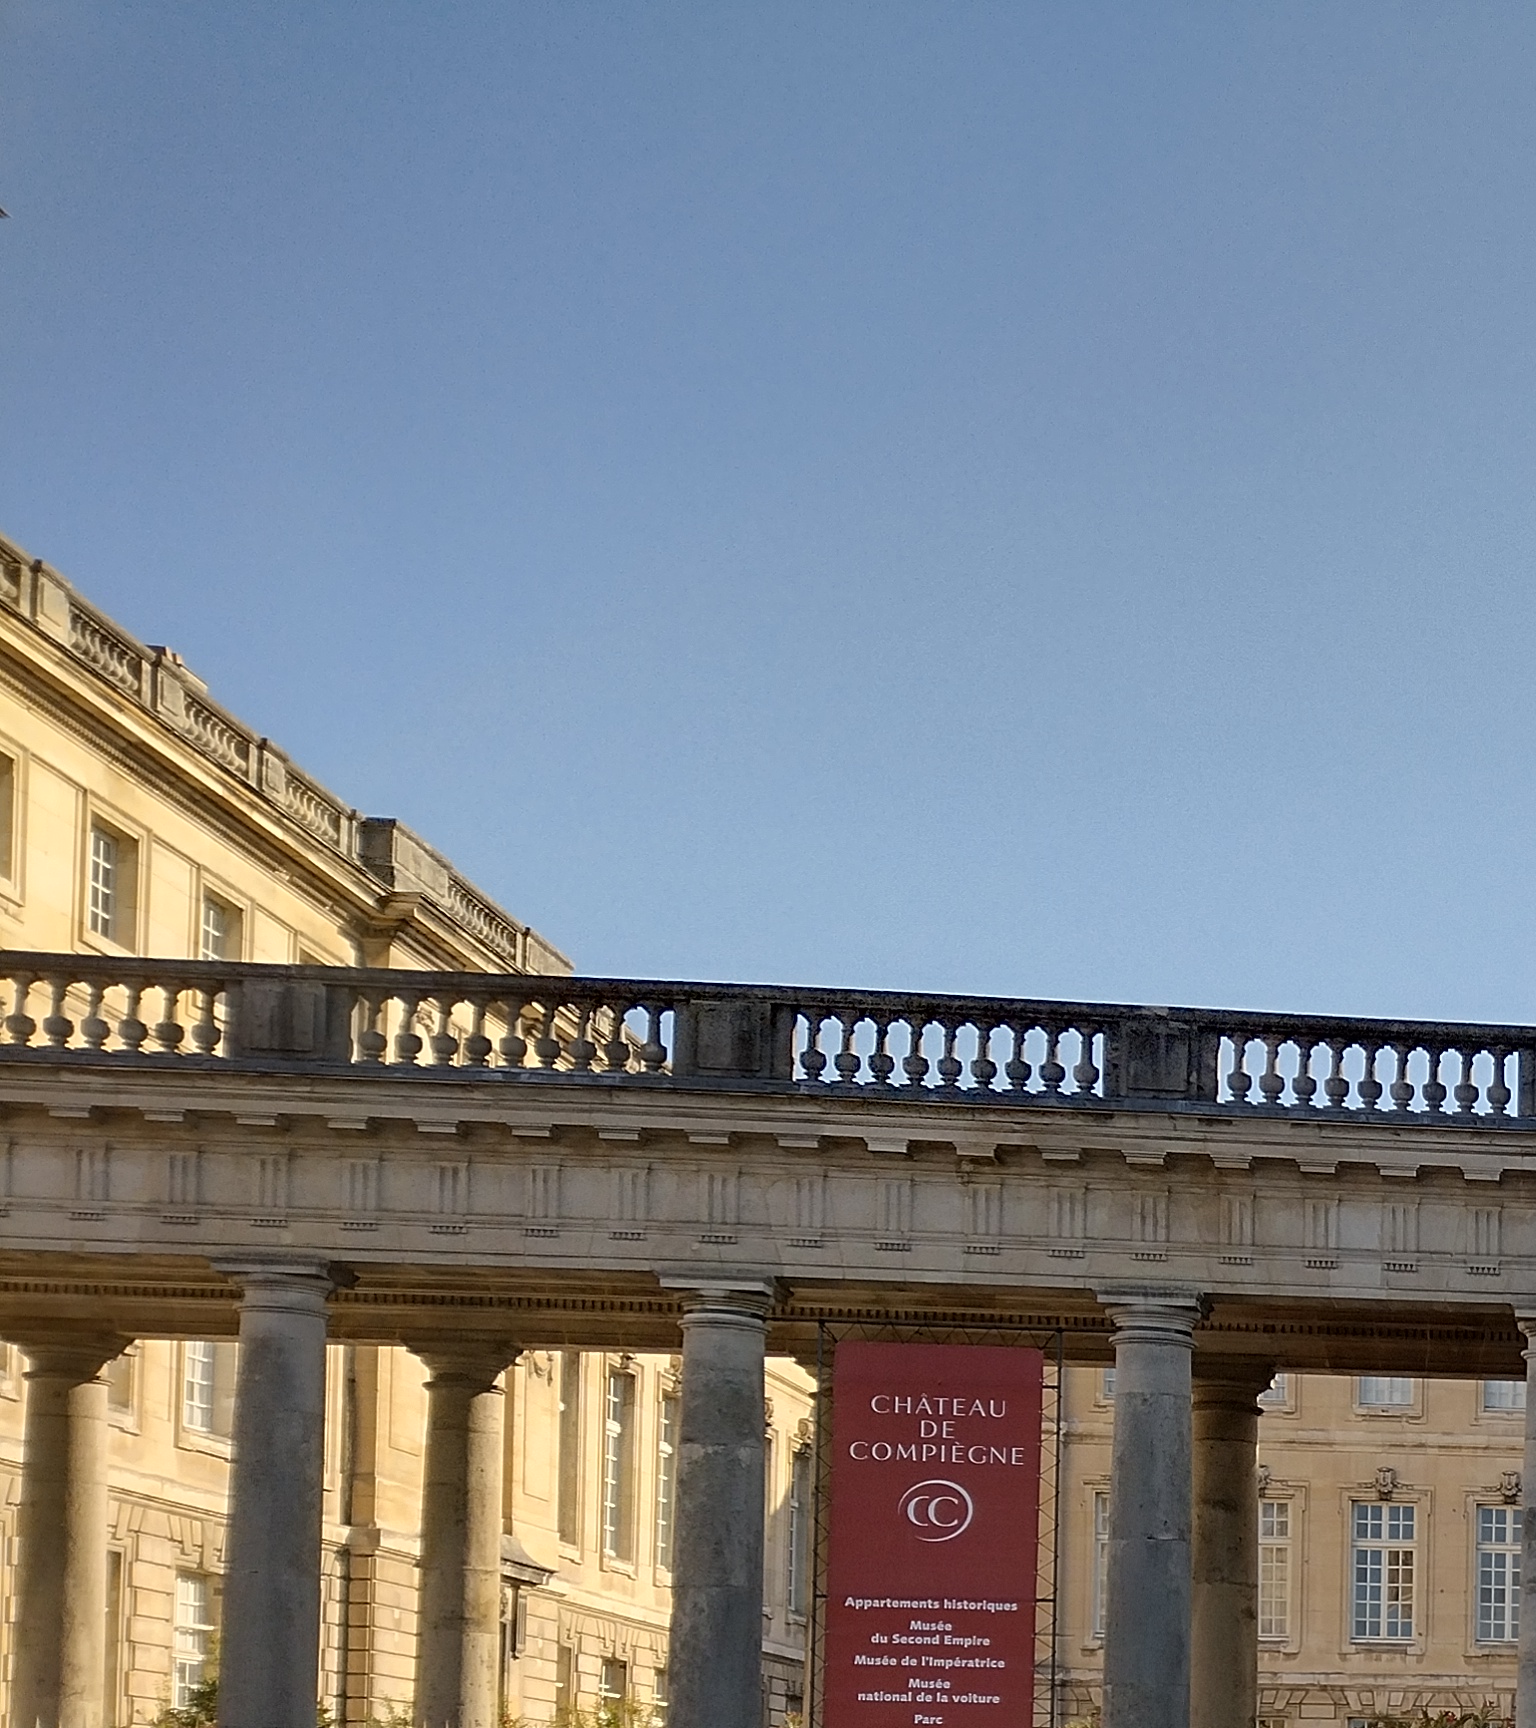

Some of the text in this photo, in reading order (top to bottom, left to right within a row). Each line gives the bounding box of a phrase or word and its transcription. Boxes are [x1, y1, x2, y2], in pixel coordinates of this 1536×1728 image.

[870, 1392, 1006, 1418] CHÂTEAU
[920, 1419, 956, 1439] DE
[849, 1441, 1025, 1466] COMPIÈGNE
[844, 1596, 1018, 1613] Appartements historiques
[909, 1620, 953, 1632] Musée
[870, 1632, 991, 1649] du Second Empire
[853, 1654, 1006, 1670] Musée de l'Impératrice
[908, 1678, 951, 1689] Musée
[857, 1690, 1001, 1704] national de la voiture
[914, 1714, 944, 1725] Parc
